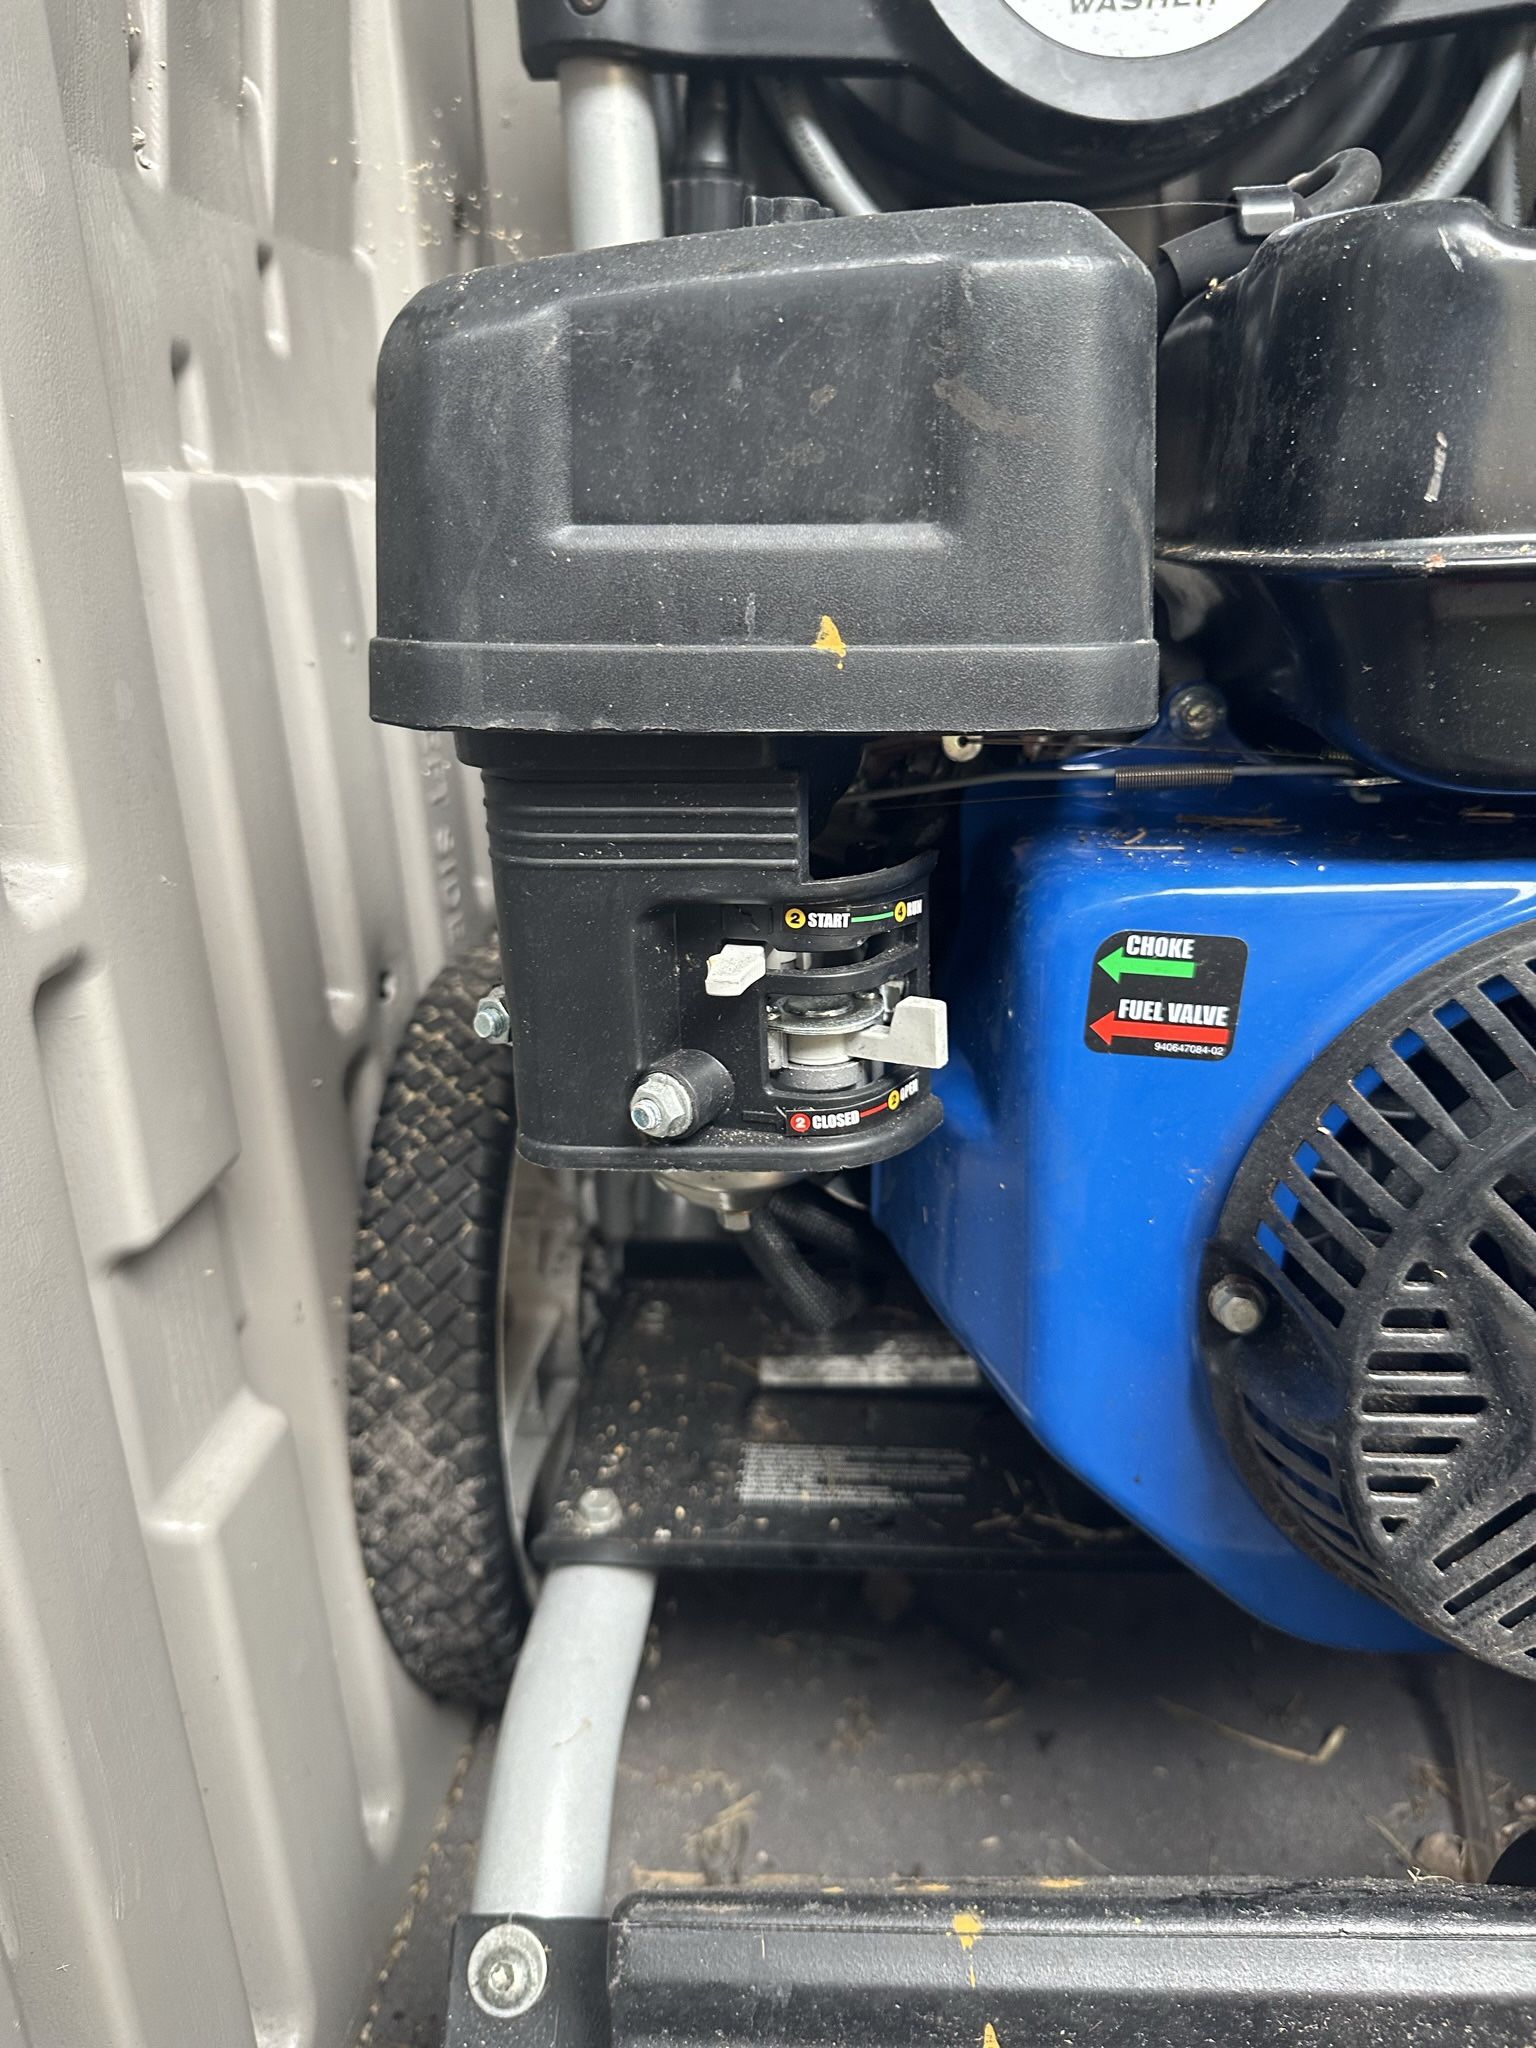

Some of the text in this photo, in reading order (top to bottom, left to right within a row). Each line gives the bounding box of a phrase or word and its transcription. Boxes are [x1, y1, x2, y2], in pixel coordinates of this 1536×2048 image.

[807, 912, 851, 929] START
[906, 899, 923, 917] RUN
[1125, 934, 1196, 960] CHOKE
[1117, 998, 1231, 1027] FUEL VALVE
[1153, 1041, 1226, 1056] 940647084-02
[811, 1109, 861, 1130] CLOSED
[899, 1078, 919, 1102] OPEN
